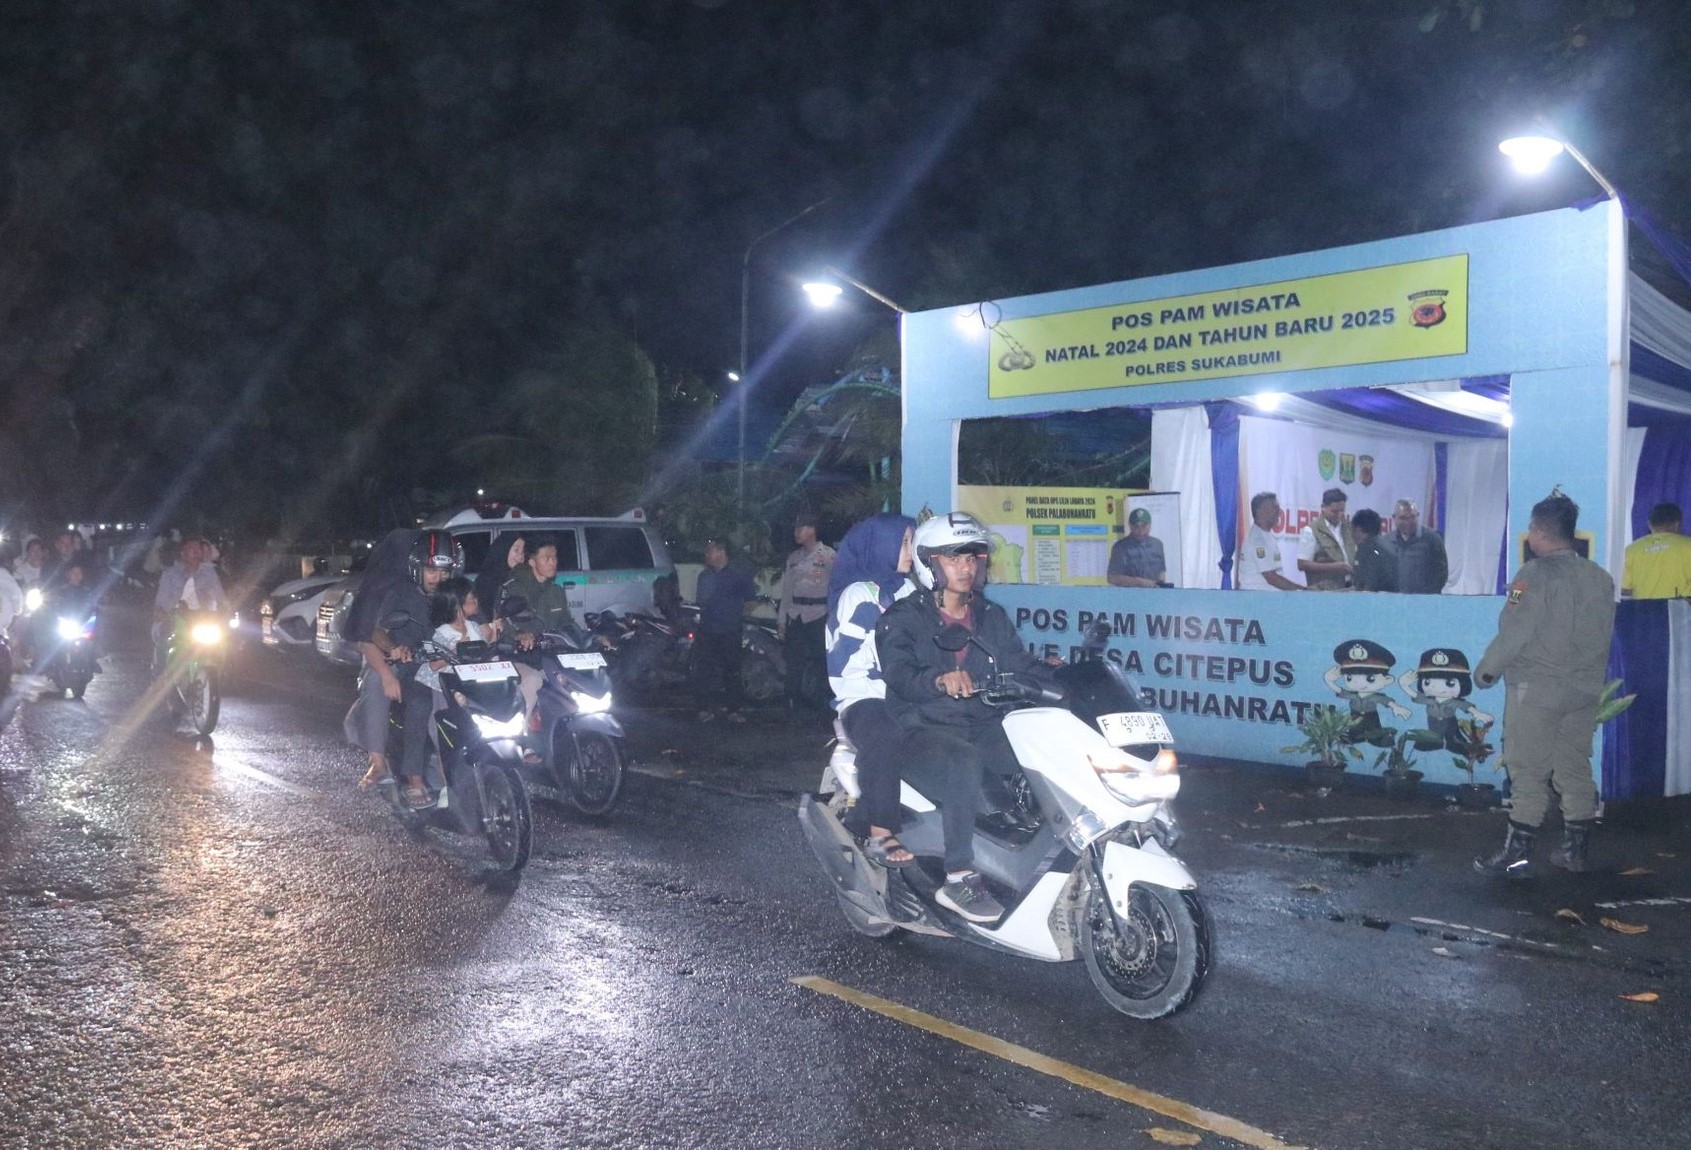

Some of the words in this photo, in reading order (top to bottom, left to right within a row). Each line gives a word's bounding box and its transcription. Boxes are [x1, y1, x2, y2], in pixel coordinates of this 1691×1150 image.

[1112, 313, 1153, 331] POS
[1160, 305, 1205, 324] PAM
[1212, 292, 1301, 318] WISATA
[1045, 343, 1099, 363] NATAL
[1105, 337, 1147, 357] 2024
[1154, 332, 1192, 351] DAN
[1199, 323, 1267, 346] TAHUN
[1275, 315, 1334, 338] BARU
[1341, 307, 1396, 330] 2025
[1126, 360, 1186, 377] POLRES
[1191, 350, 1281, 371] SUKABUMI
[1026, 508, 1048, 519] POLSEK
[1016, 607, 1068, 632] POS
[1146, 613, 1267, 646] WISATA
[1154, 652, 1295, 686] CITEPUS
[1102, 718, 1110, 731] F
[1120, 715, 1146, 727] 4890
